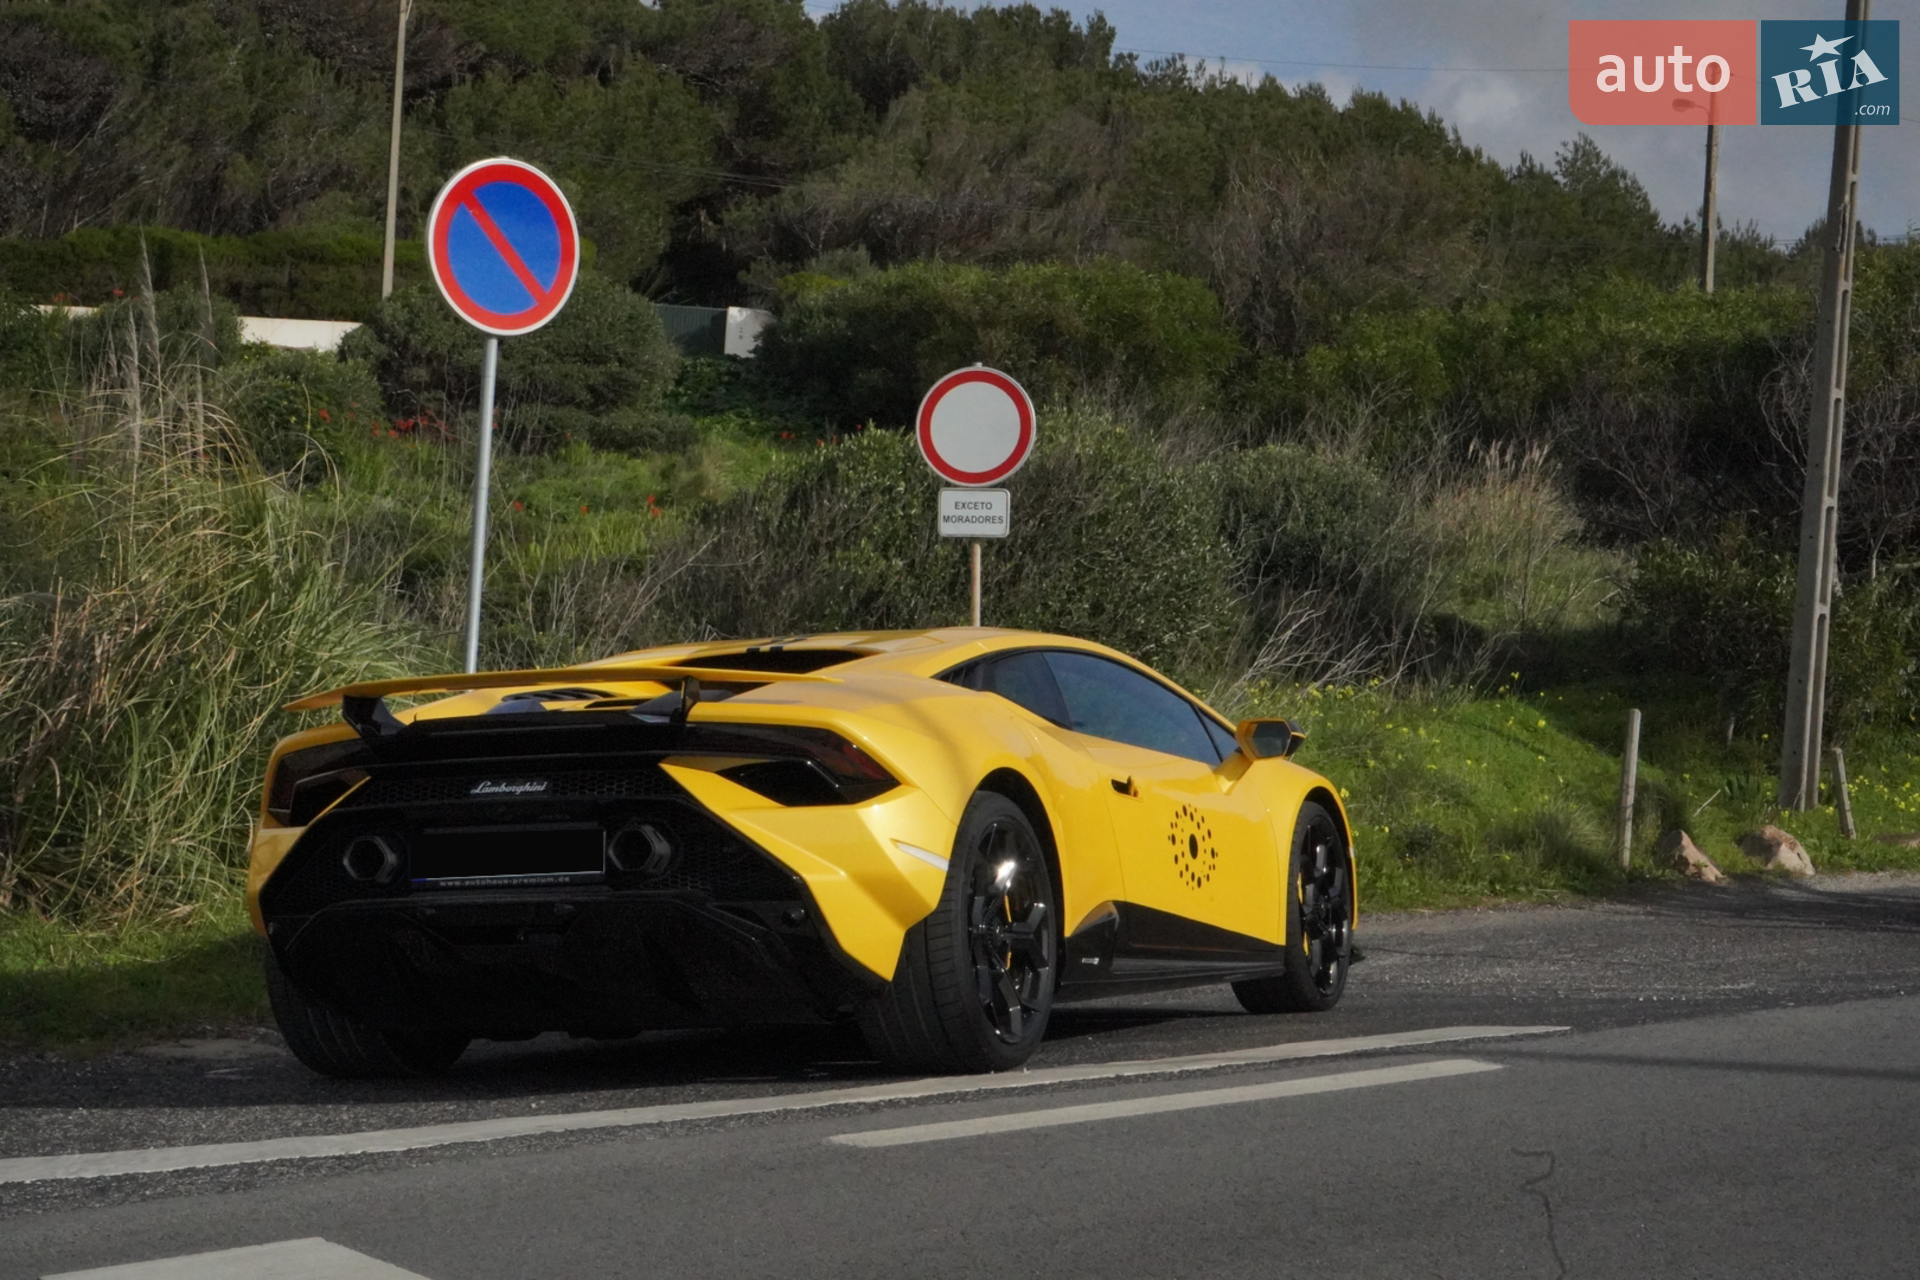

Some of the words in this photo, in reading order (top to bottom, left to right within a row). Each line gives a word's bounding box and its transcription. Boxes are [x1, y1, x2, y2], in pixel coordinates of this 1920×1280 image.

[954, 501, 993, 511] EXCETO
[942, 515, 1004, 524] MORADORES
[470, 780, 548, 795] Lamborghini
